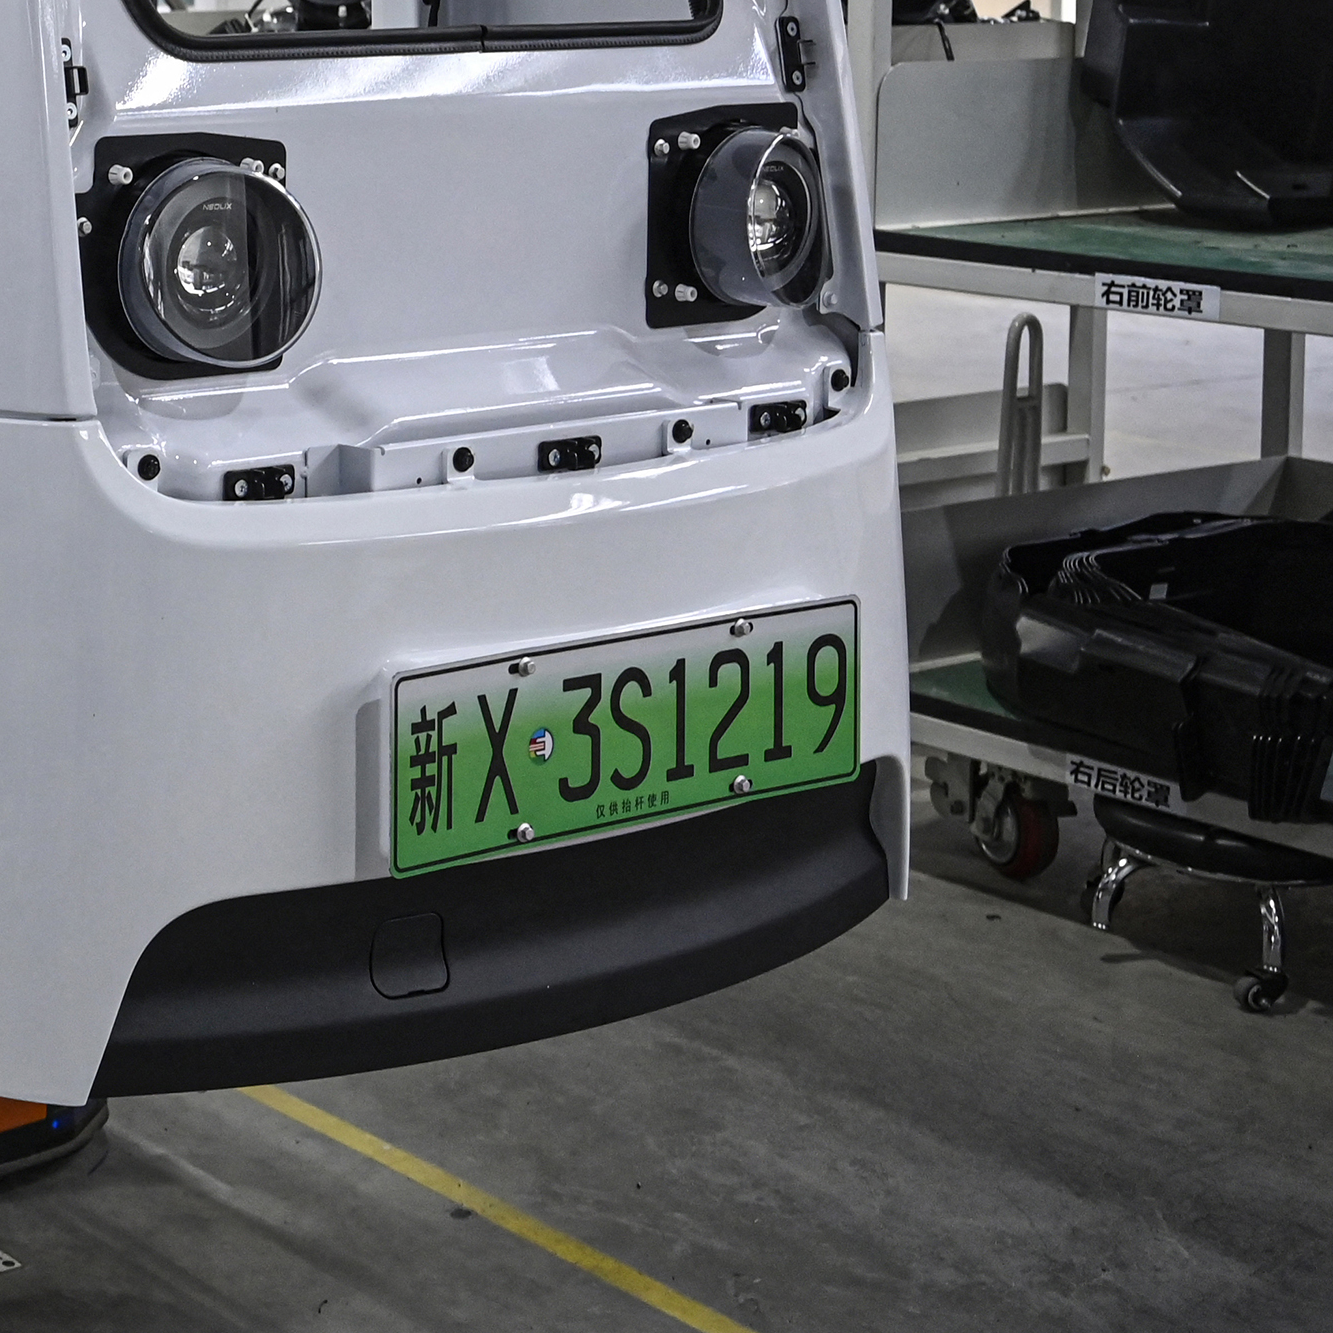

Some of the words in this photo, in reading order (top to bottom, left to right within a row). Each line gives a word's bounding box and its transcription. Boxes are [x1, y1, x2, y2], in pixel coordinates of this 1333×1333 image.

[1101, 280, 1203, 315] 右前轮罩
[558, 633, 847, 803] 3S1219
[596, 790, 670, 819] 仅供抬杆使用
[1070, 760, 1171, 808] 右后轮罩
